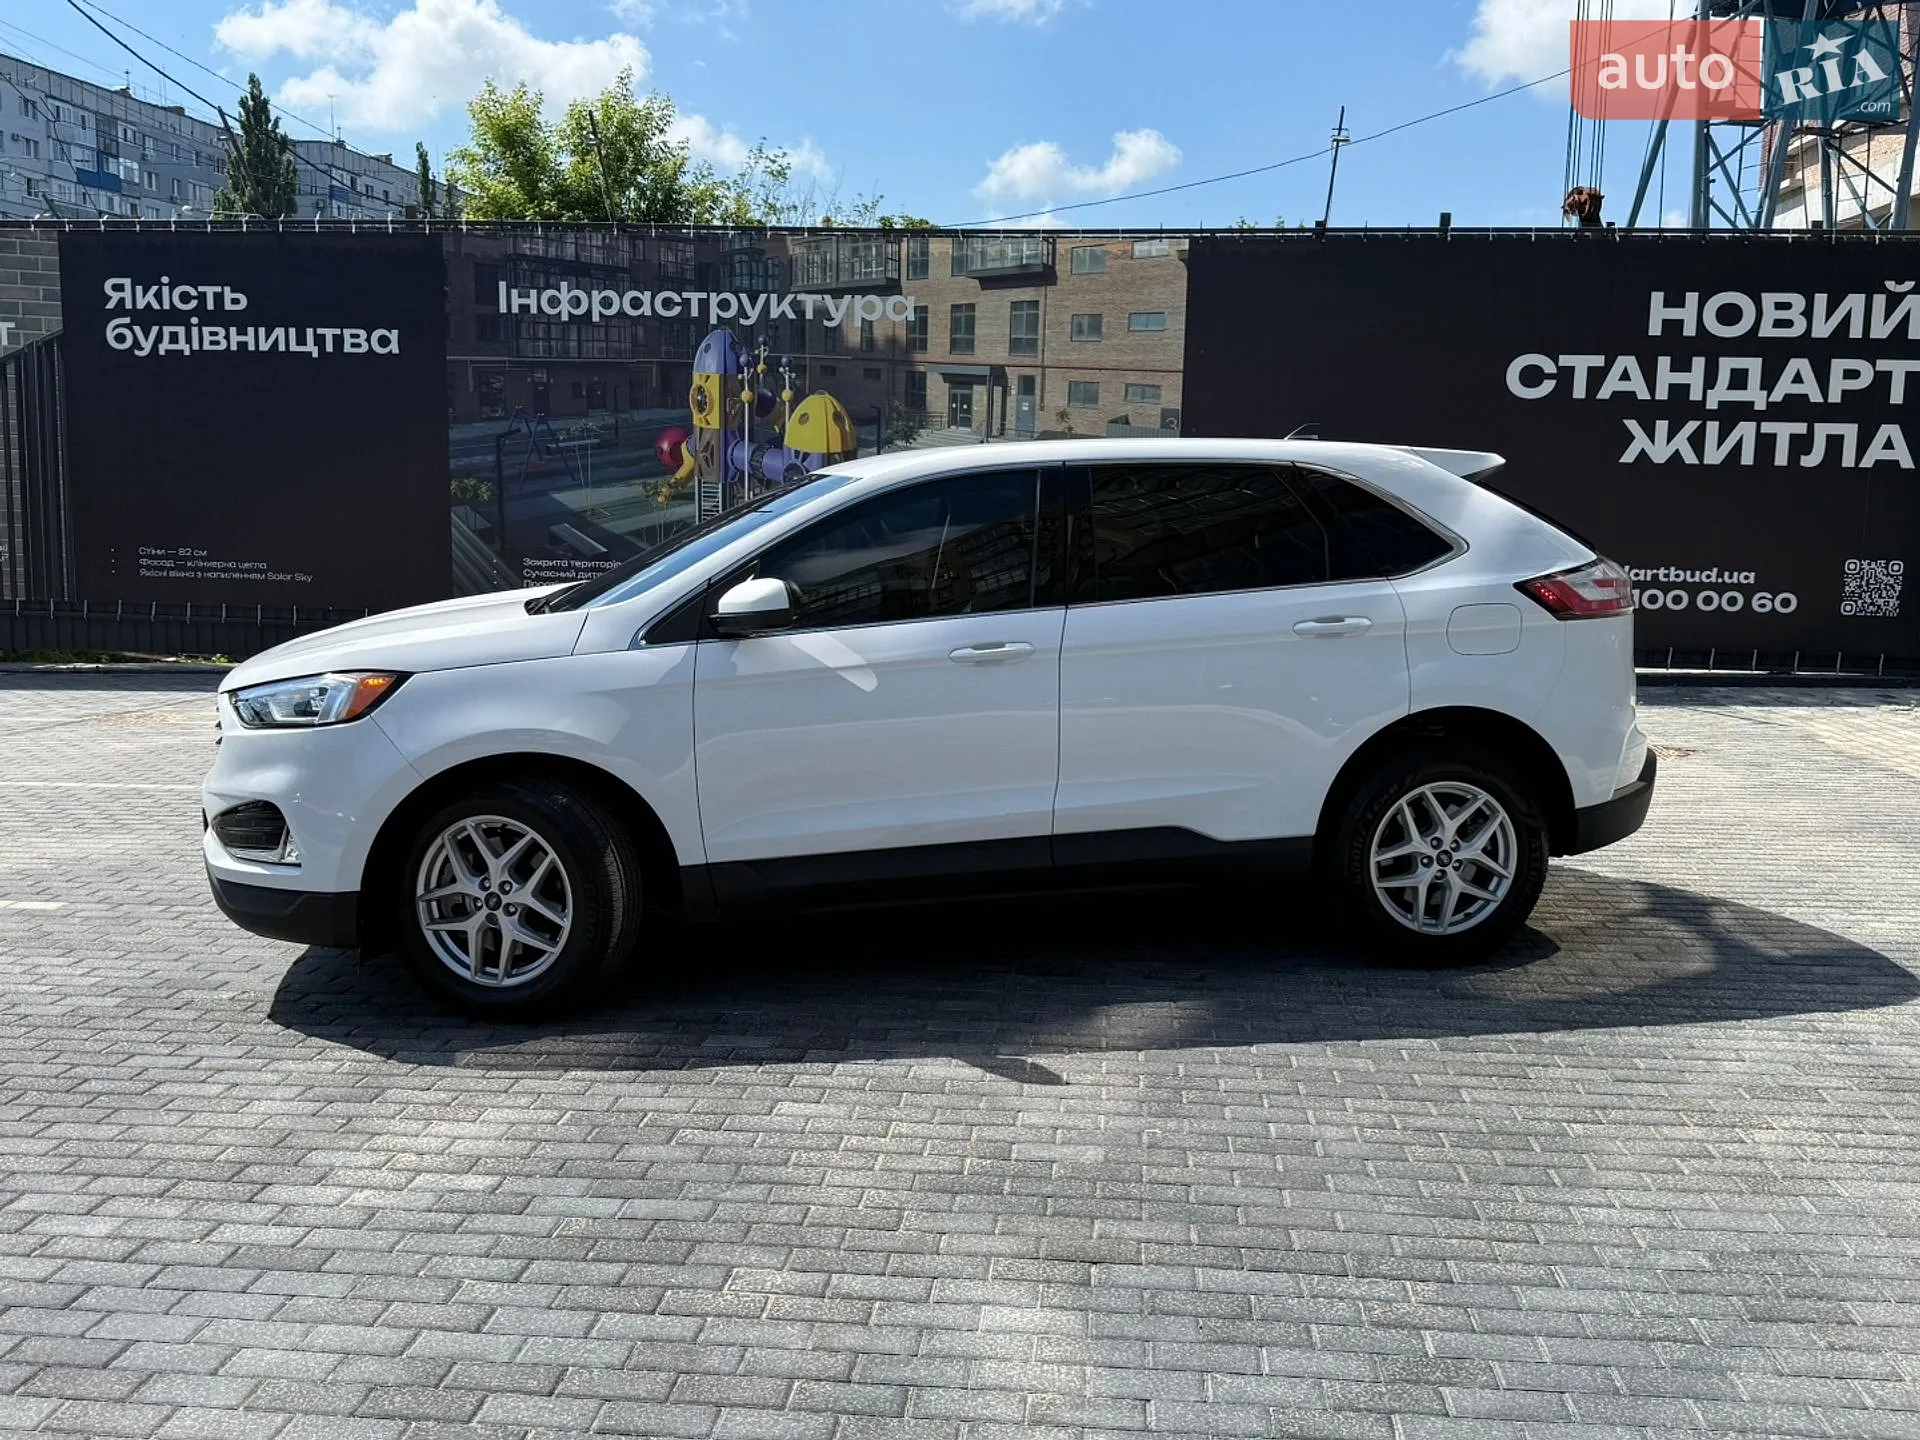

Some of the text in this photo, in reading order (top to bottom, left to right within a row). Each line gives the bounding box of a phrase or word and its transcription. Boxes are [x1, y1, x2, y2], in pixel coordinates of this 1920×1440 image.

[103, 276, 248, 311] Якість
[498, 281, 915, 327] Інфраструктура
[1647, 280, 1920, 340] НОВИЙ
[105, 317, 400, 358] будівництва
[1505, 354, 1920, 410] СТАНДАРТ
[1618, 419, 1916, 469] ЖИТЛА
[138, 558, 175, 567] Фасад
[178, 548, 192, 556] 82
[522, 557, 568, 568] Закрита
[294, 573, 313, 582] Sky
[522, 568, 577, 578] Сучасний
[1624, 565, 1756, 584] artbud.ua
[1696, 590, 1744, 612] 00
[1751, 591, 1798, 614] 60
